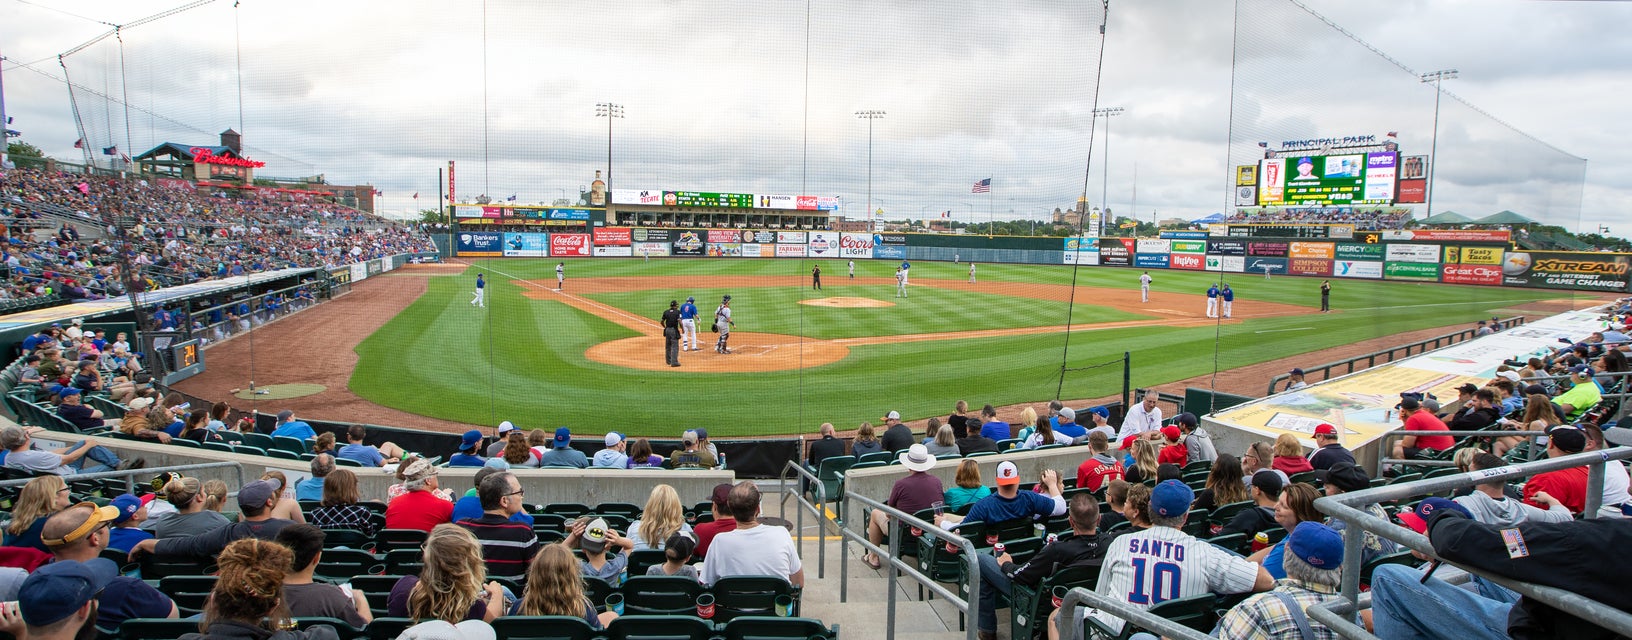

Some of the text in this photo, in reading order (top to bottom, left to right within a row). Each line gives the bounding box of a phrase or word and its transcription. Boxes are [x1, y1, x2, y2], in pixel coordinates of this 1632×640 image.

[1282, 135, 1376, 148] PRINCIPAL PARK
[190, 147, 266, 168] Budweiser
[640, 195, 660, 203] TECATE
[554, 235, 582, 246] Coca-Cola
[840, 236, 873, 248] Coors
[1366, 234, 1378, 244] 24
[1444, 266, 1499, 277] Great Clips
[1534, 259, 1628, 274] XTREAM
[1577, 280, 1626, 288] CHANGER
[184, 344, 195, 366] 24
[1129, 538, 1184, 562] SANTO
[1128, 558, 1182, 604] 10
